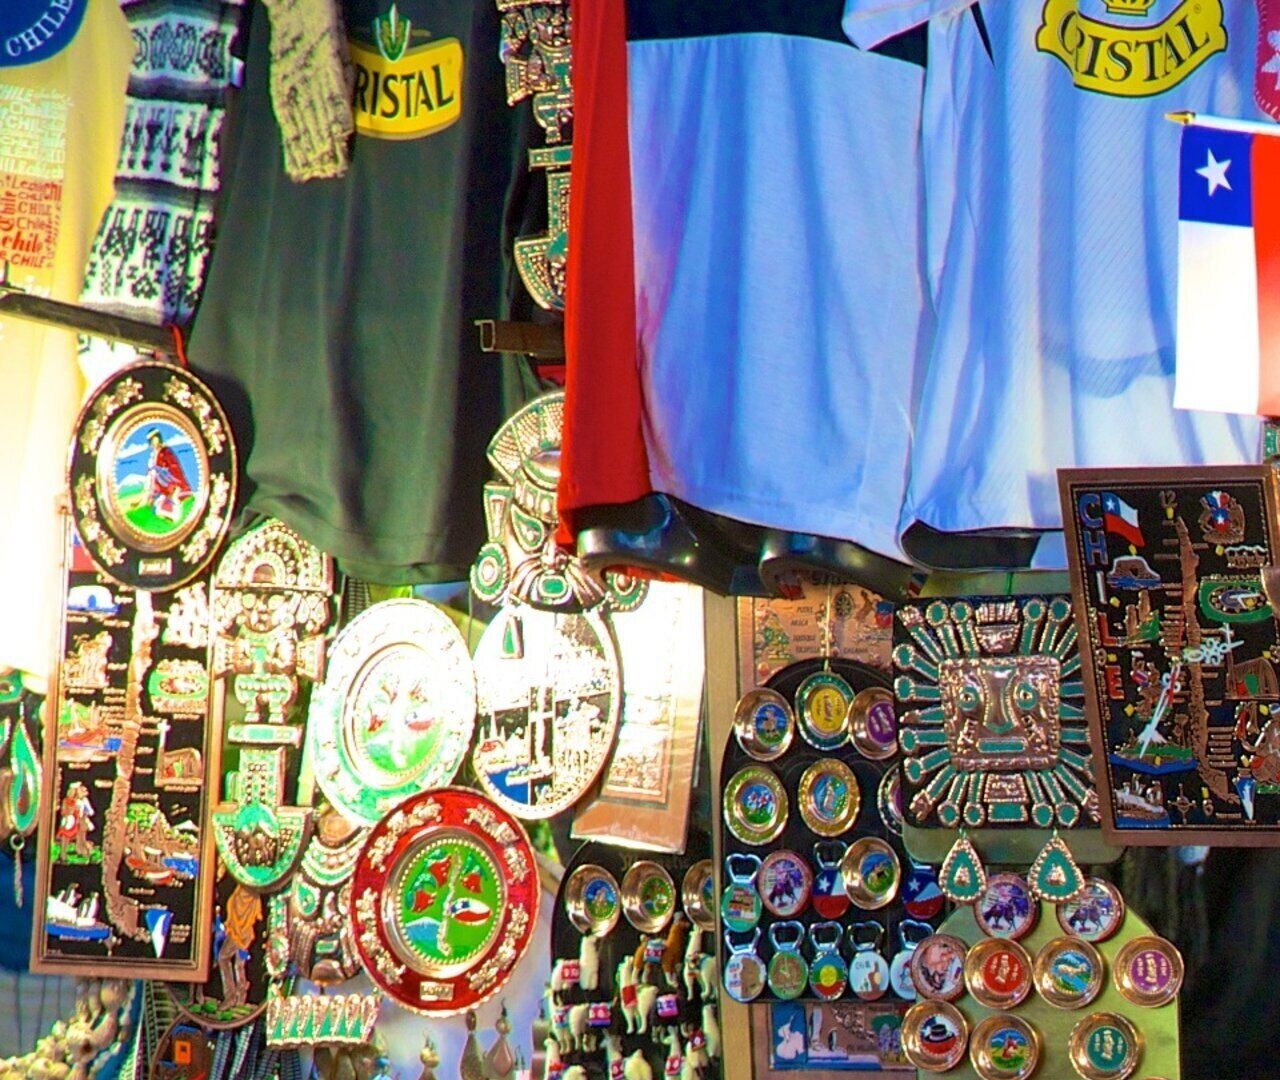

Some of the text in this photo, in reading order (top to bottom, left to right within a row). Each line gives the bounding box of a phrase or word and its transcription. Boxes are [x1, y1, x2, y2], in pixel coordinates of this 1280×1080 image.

[6, 0, 73, 57] CHILE
[353, 63, 454, 119] RISTAL
[1159, 490, 1177, 509] 12
